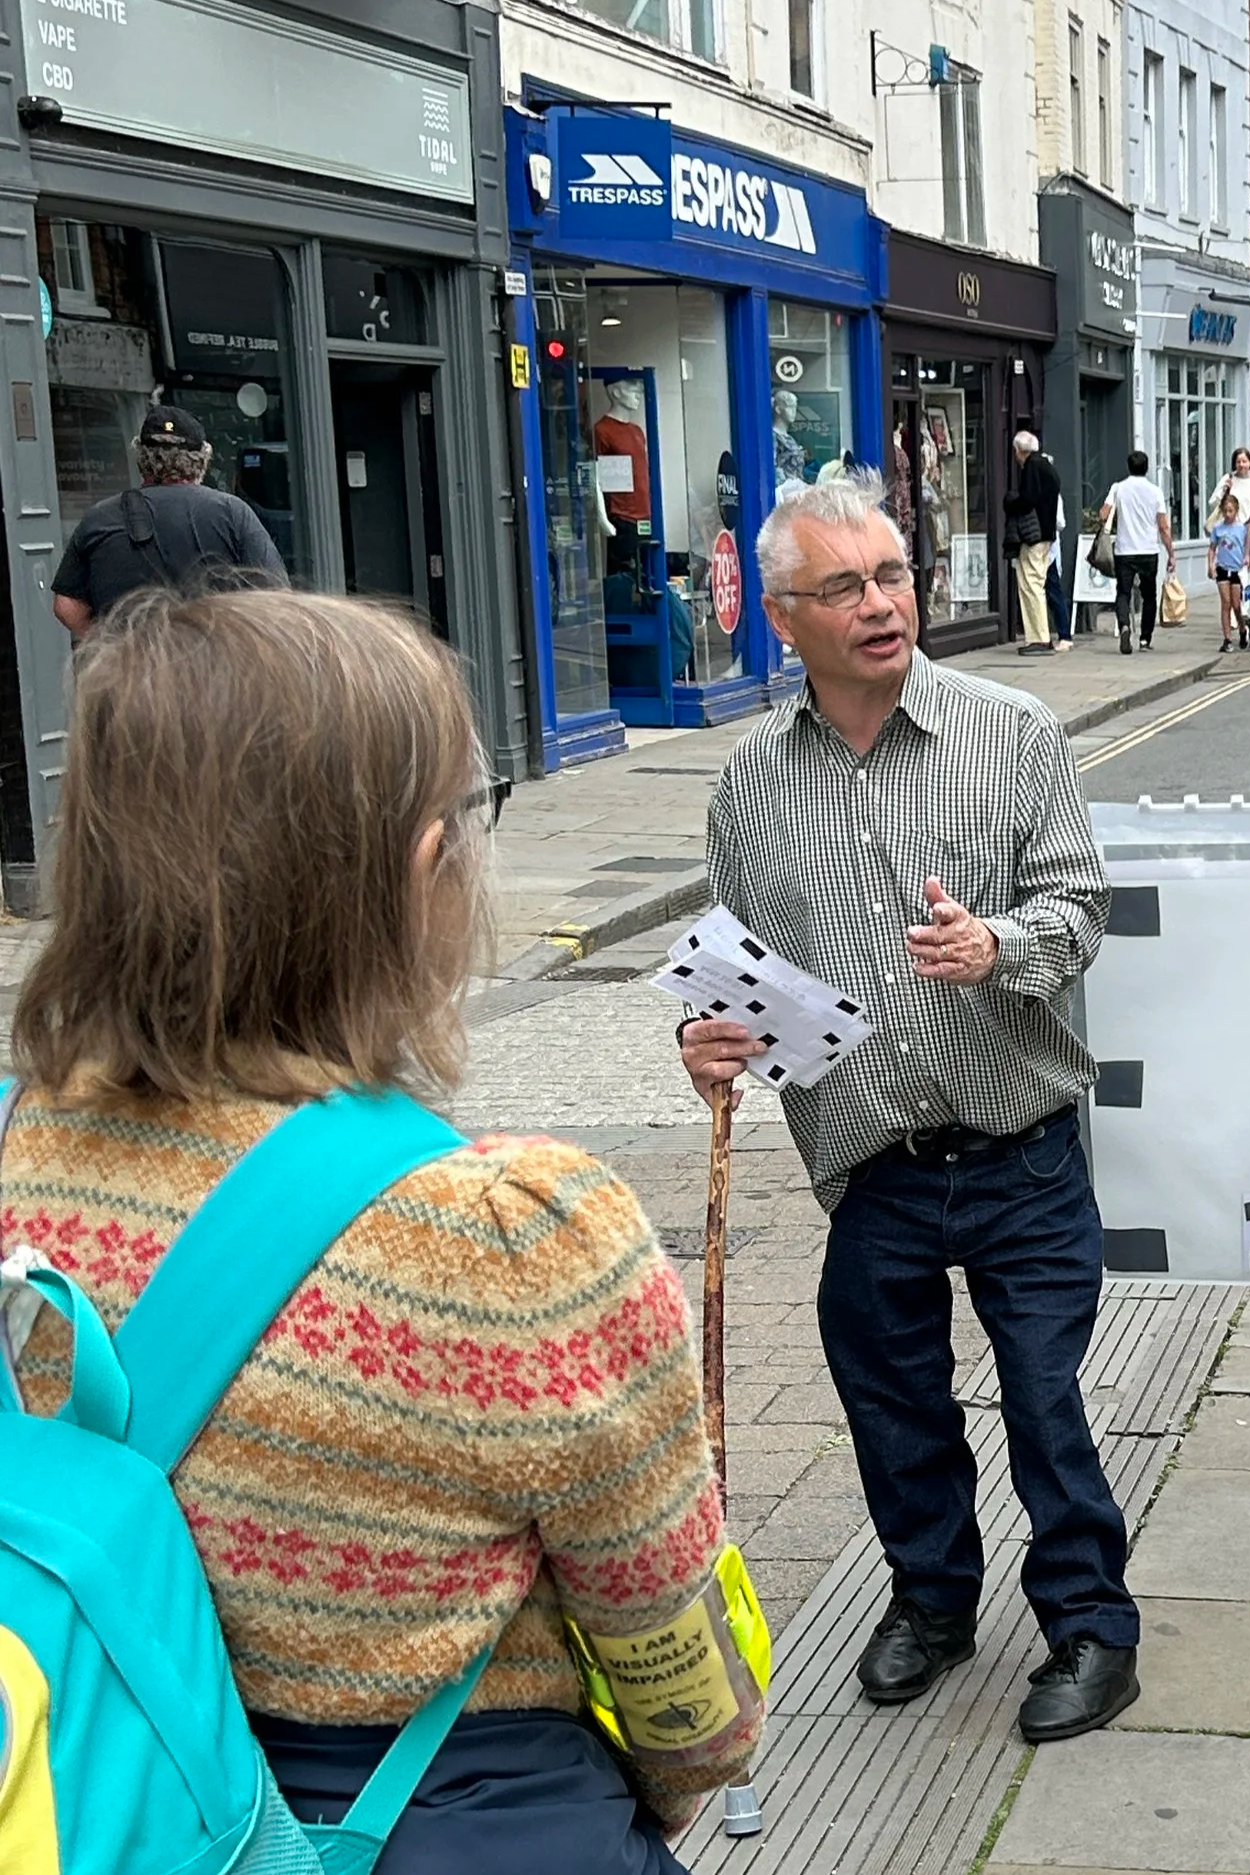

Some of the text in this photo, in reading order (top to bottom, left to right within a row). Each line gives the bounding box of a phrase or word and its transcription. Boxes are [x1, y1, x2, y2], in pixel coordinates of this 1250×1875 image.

[38, 19, 77, 52] VAPE
[42, 61, 74, 91] CBD
[419, 134, 458, 165] TIDAL
[568, 186, 664, 206] TRESPASS
[672, 154, 767, 241] ESPASS
[718, 474, 740, 495] FINAL
[714, 552, 737, 586] 70%
[716, 585, 738, 613] OFF
[607, 1628, 705, 1671] VISUALLY
[630, 1629, 677, 1655] I AM
[616, 1645, 710, 1686] IMPAIRED
